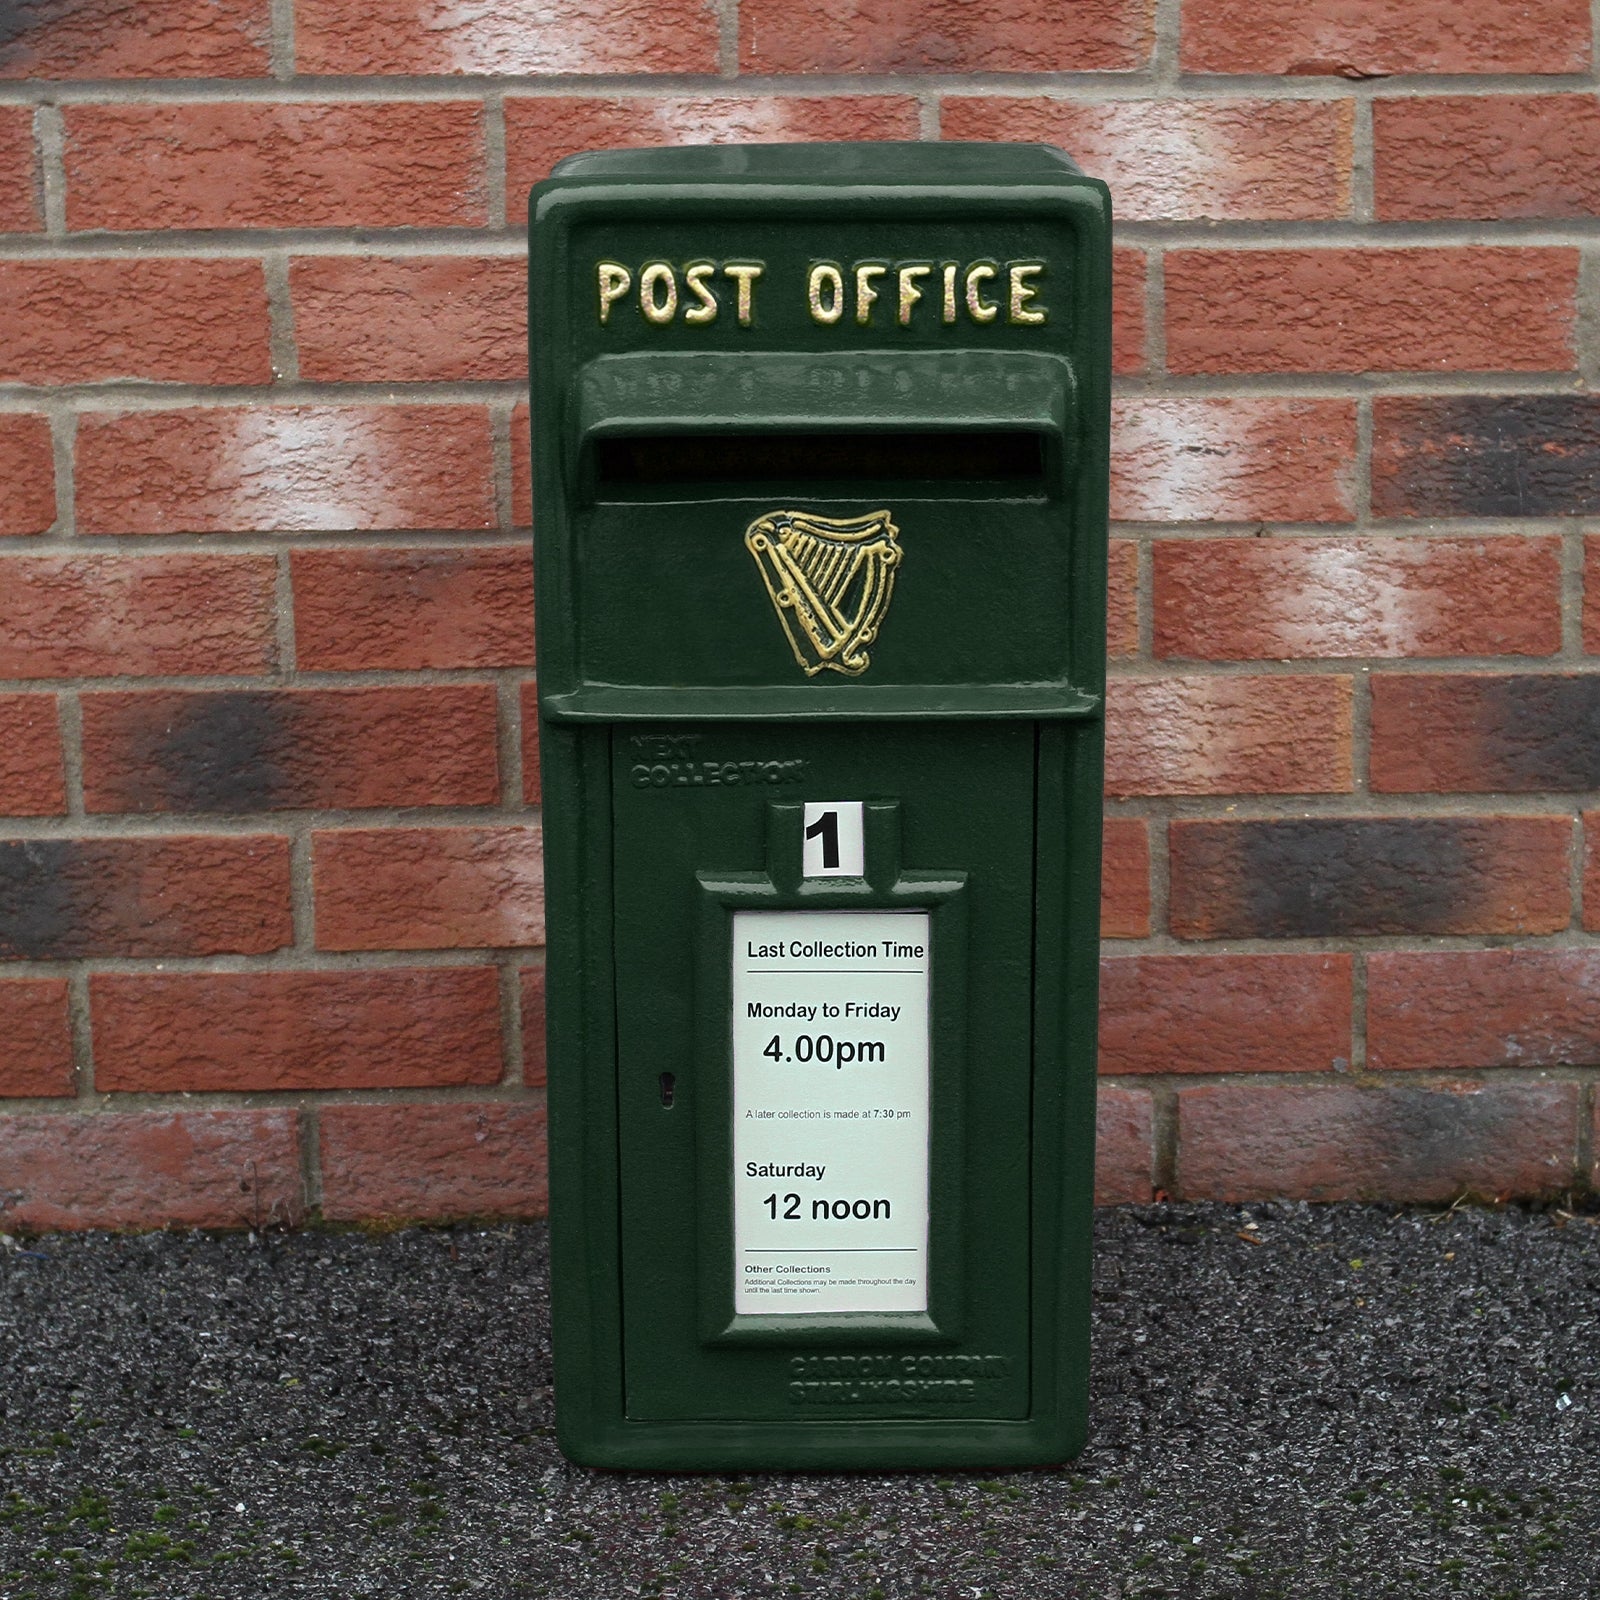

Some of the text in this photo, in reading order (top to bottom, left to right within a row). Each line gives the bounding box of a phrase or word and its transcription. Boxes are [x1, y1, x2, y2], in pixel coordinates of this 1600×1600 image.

[597, 262, 1046, 325] POST OFFICE
[630, 759, 808, 790] COLLECTION
[804, 810, 840, 869] 1
[748, 941, 924, 958] Last Collection Time
[748, 1002, 901, 1021] Monday to Friday
[763, 1035, 885, 1069] 4.00pm
[746, 1109, 911, 1121] A later collection is made at 7:30 pm
[746, 1162, 826, 1181] Saturday
[763, 1193, 891, 1220] 12 noon
[744, 1264, 831, 1274] Other Collections
[744, 1278, 917, 1287] Additional Collections may be made throughout the day
[744, 1286, 821, 1294] until the last time shown.
